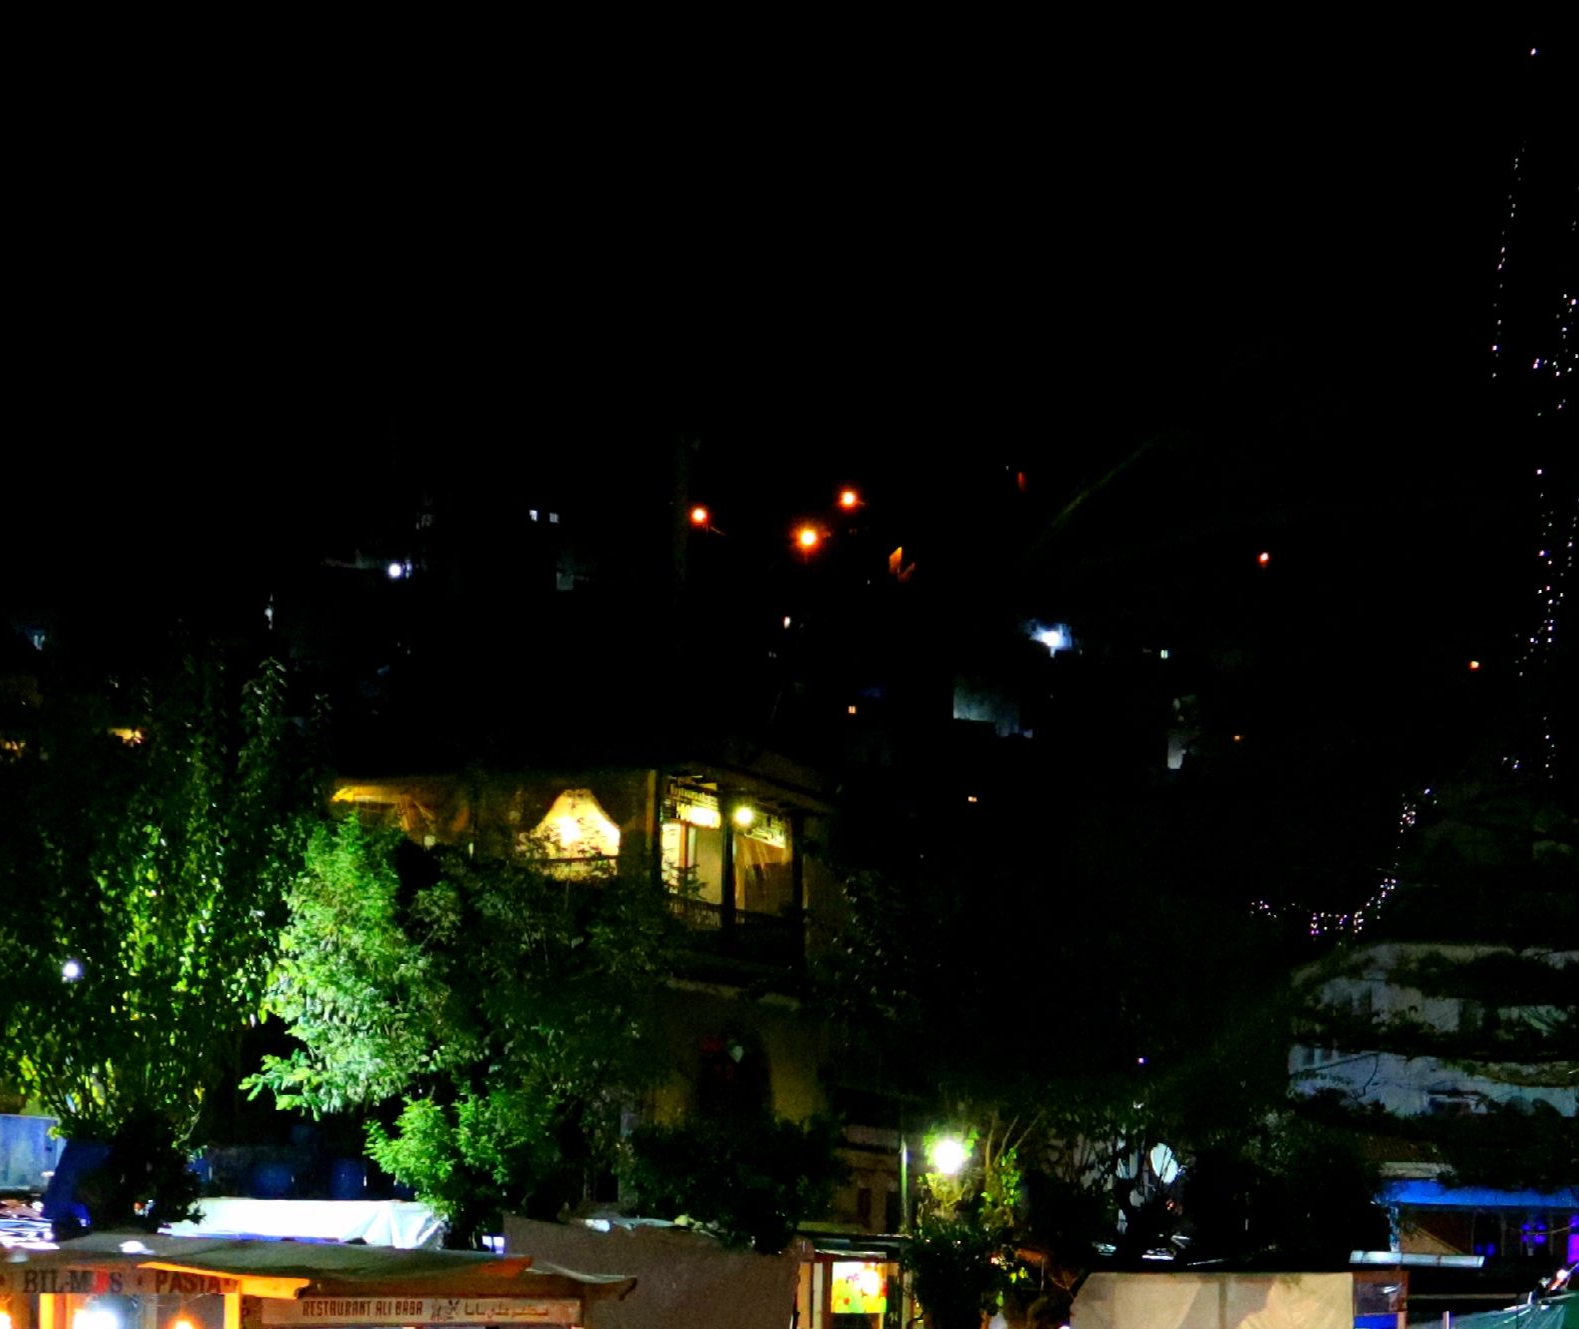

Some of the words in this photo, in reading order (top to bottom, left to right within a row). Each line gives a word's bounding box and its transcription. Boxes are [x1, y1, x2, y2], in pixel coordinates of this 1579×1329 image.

[302, 1300, 372, 1317] RESTAURANT
[375, 1300, 393, 1316] ALI
[395, 1300, 423, 1316] BABA
